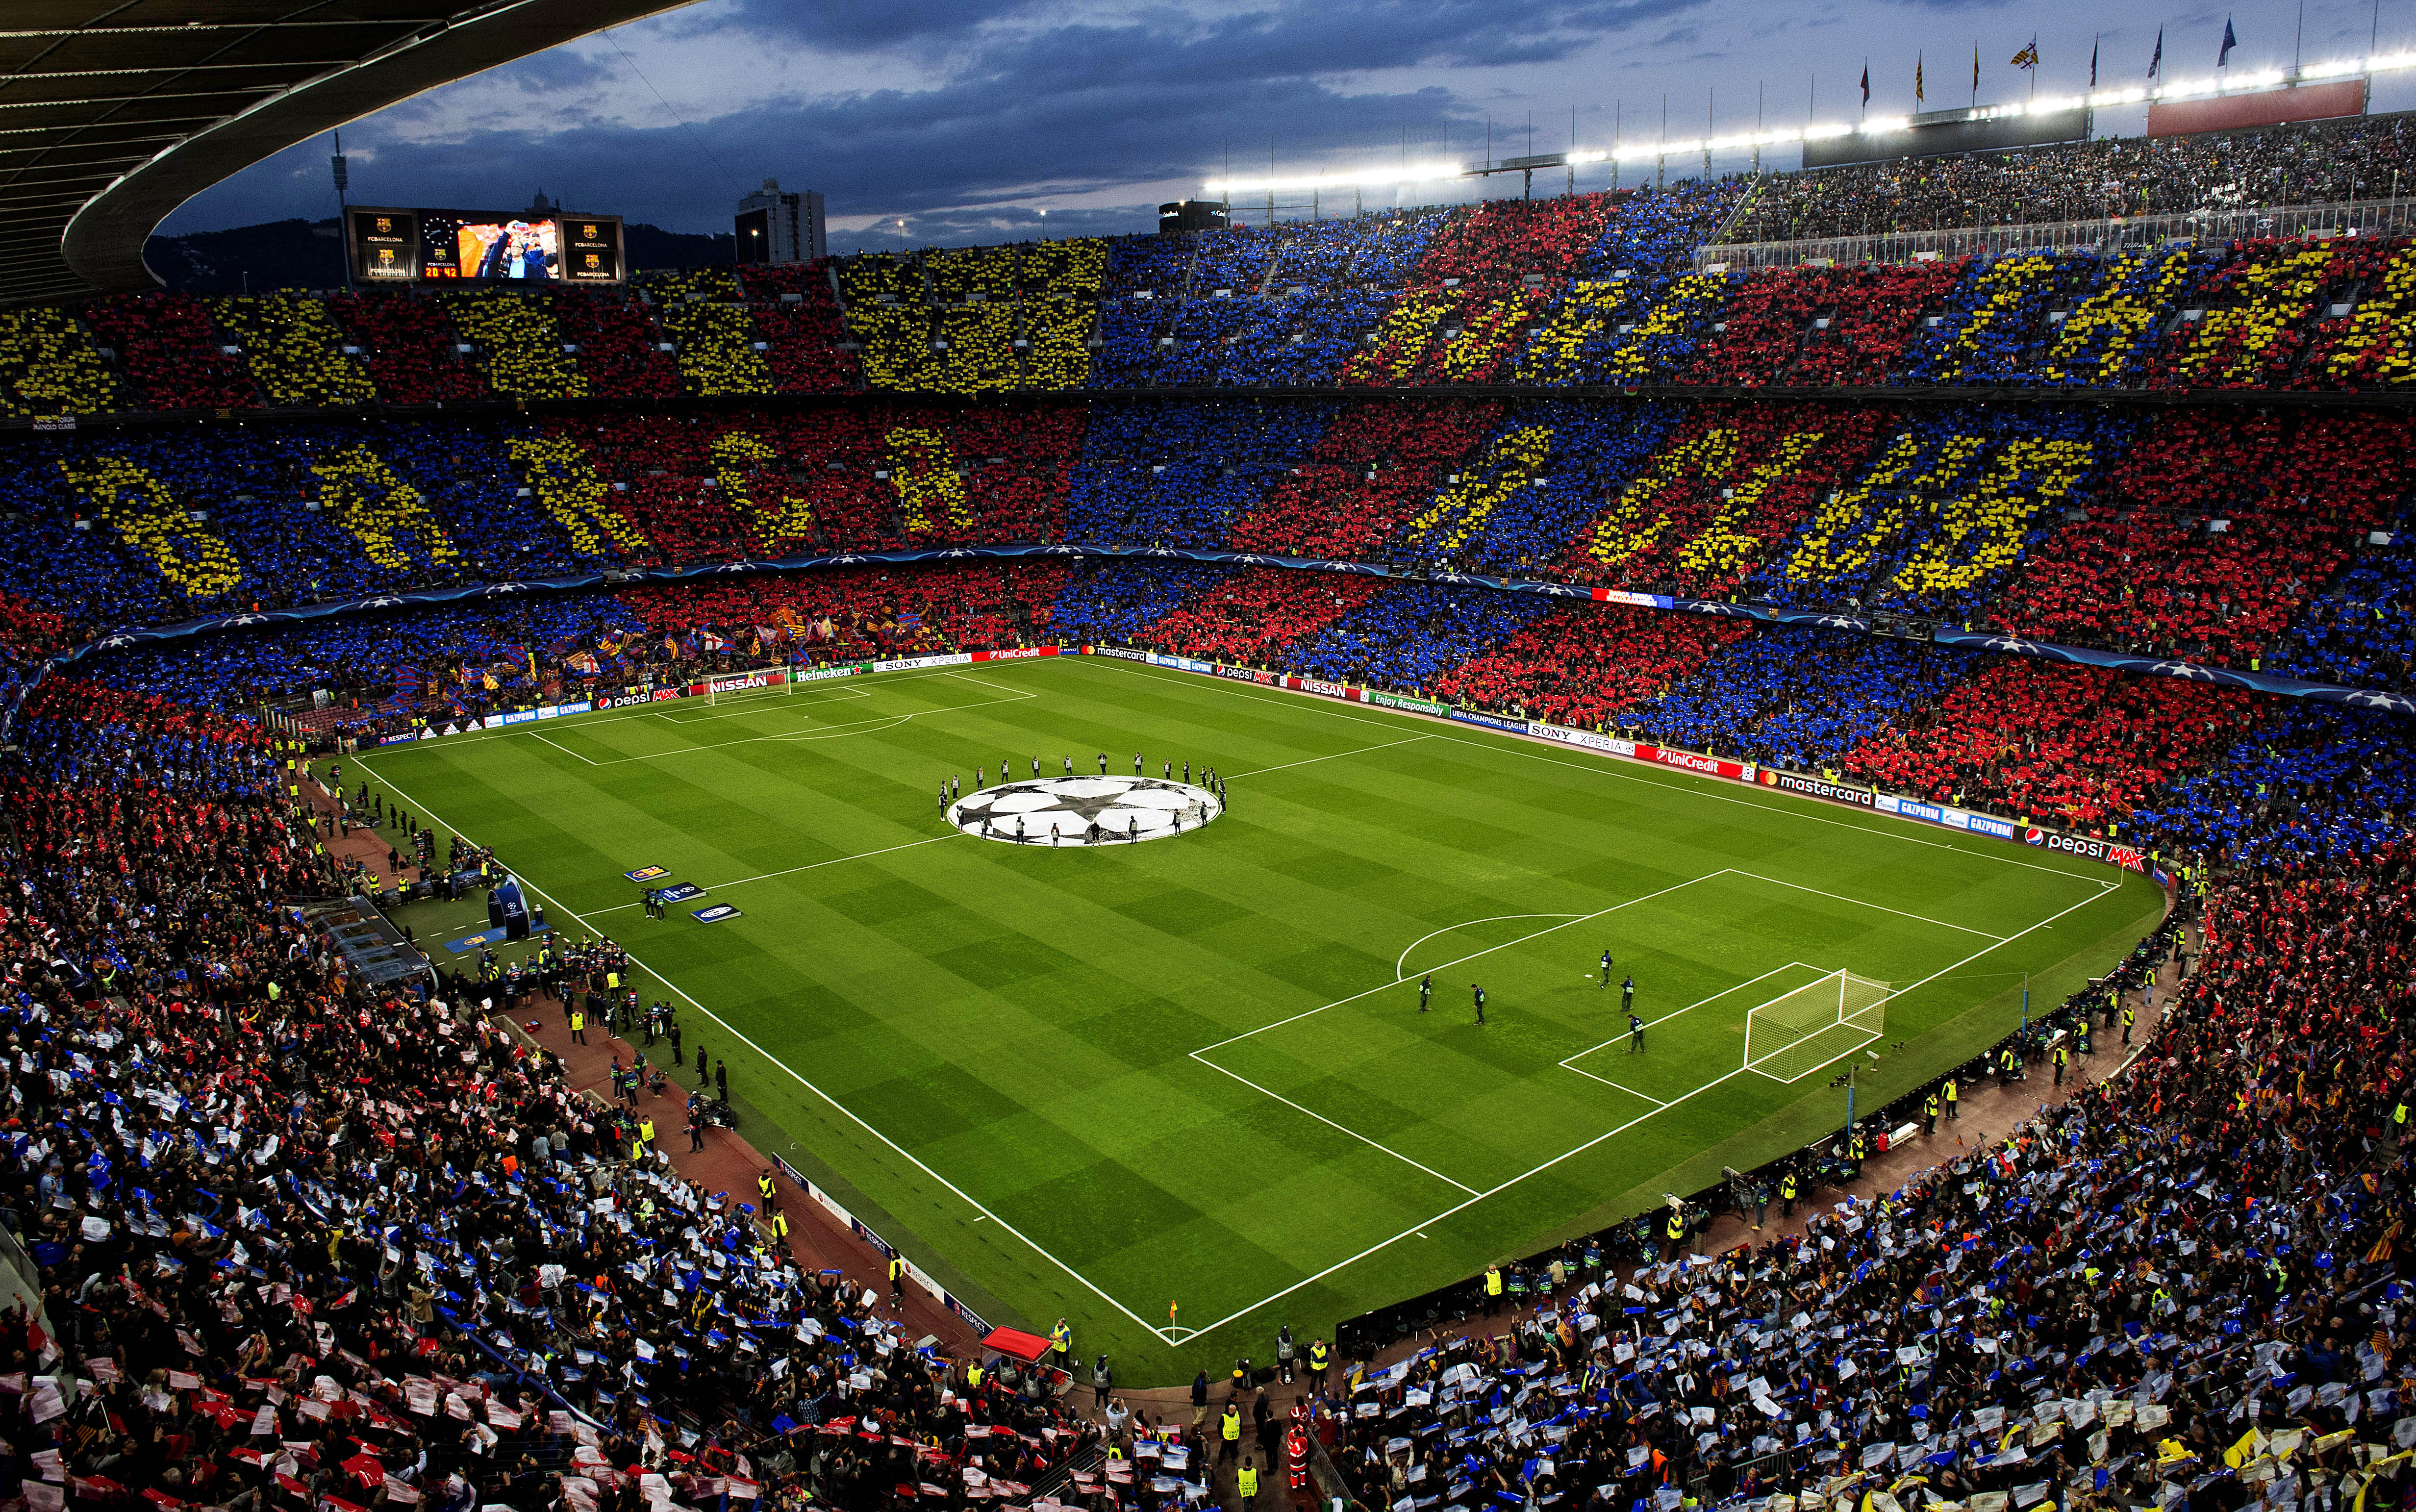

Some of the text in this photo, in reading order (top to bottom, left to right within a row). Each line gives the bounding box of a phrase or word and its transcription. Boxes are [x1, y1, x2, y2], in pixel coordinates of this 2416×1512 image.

[886, 655, 969, 669] SONY XPERIA
[999, 648, 1040, 659] UniCredit
[1097, 647, 1145, 661] mastercard
[1158, 656, 1177, 667] GAZPROM
[797, 666, 852, 682] Heineken
[1191, 662, 1211, 673] GAZPROM
[1227, 668, 1275, 685] pepsi MAX
[710, 676, 767, 692] NISSAN
[1301, 680, 1346, 697] NISSAN
[615, 687, 681, 708] pepsi MAX
[1375, 694, 1444, 716] Enjoy Responsibly
[505, 711, 536, 723] GAZPROM
[559, 702, 589, 714] GAZPROM
[1452, 709, 1527, 731] UEFA CHAMPIONS LEAGUE
[388, 732, 414, 742] RESPECT
[1532, 725, 1622, 752] SONY XPERIA
[1667, 751, 1719, 773] UniCredit
[1781, 776, 1871, 805] mastercard
[1901, 802, 1939, 820] GAZPROM
[1970, 817, 2011, 837] GAZPROM
[2048, 834, 2147, 872] pepsi MAX
[785, 1166, 802, 1184] RESPECT
[824, 1197, 841, 1216] RESPECT
[866, 1231, 886, 1253] RESPECT
[912, 1269, 933, 1291] RESPECT
[961, 1309, 986, 1334] RESPECT
